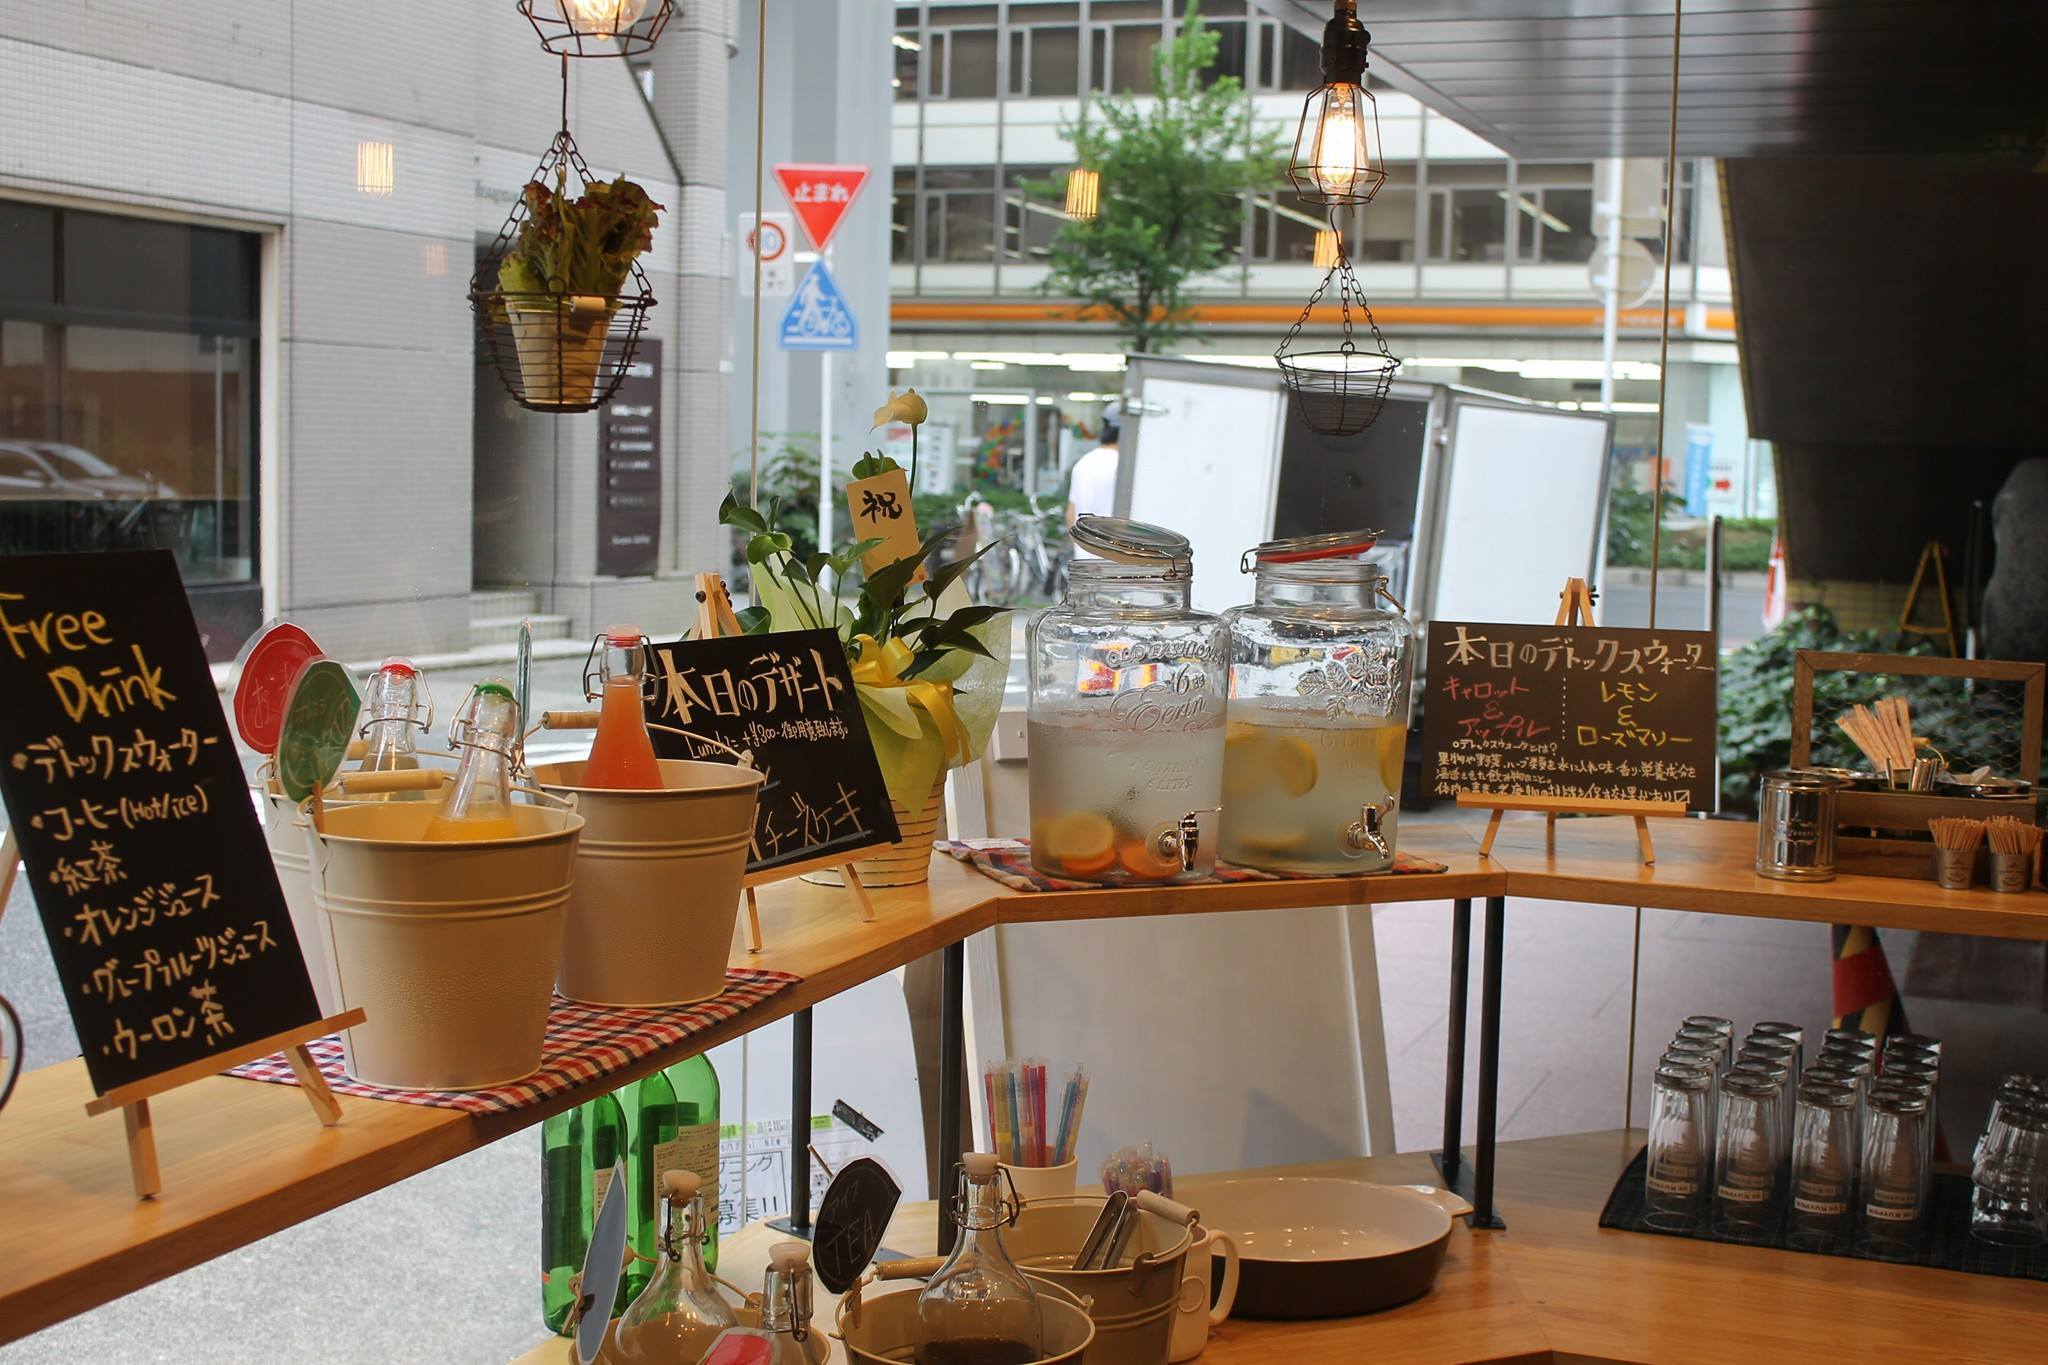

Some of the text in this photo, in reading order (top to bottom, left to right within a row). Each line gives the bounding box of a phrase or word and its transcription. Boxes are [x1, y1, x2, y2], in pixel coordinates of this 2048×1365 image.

[795, 182, 850, 203] 止まれ
[860, 489, 903, 524] 祝
[0, 593, 114, 660] Free
[48, 644, 177, 723] Drink
[651, 648, 843, 725] 本日のデザート
[1442, 677, 1530, 701] キャロット
[1601, 681, 1658, 703] レモン
[26, 728, 219, 783] デトックスウォーター
[1458, 717, 1550, 740] アップル
[1577, 725, 1694, 748] ローズマリー
[57, 840, 128, 896] 紅茶
[75, 874, 221, 946] オレンジジュース
[93, 920, 278, 1003] グレープフルーツジュース
[114, 979, 235, 1060] ウーロン茶
[826, 1209, 874, 1276] TEA
